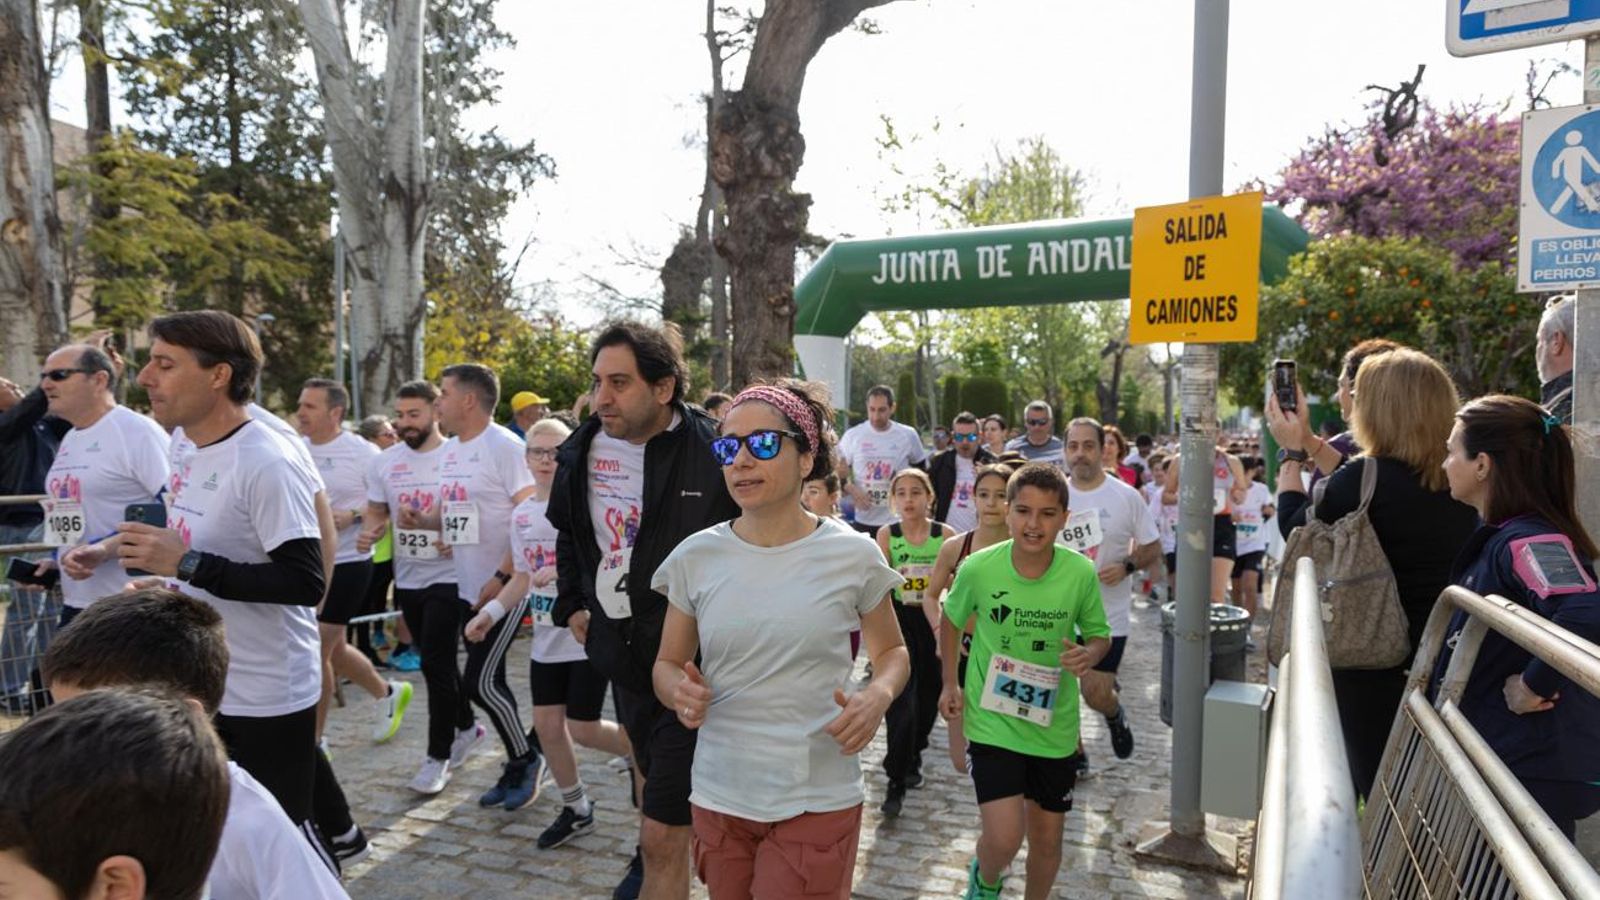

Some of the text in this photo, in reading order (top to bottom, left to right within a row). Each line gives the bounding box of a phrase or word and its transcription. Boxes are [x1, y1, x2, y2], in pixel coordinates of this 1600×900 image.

[1165, 212, 1227, 244] SALIDA
[1539, 240, 1558, 252] ES
[872, 236, 1132, 284] JUNTA DE ANDAL
[1556, 253, 1600, 265] LLEVA
[1184, 255, 1205, 281] DE
[1534, 266, 1596, 281] PERROS
[1146, 295, 1238, 325] CAMIONES
[49, 516, 81, 532] 1086
[445, 517, 469, 531] 947
[399, 533, 428, 547] 923
[1063, 523, 1092, 542] 681
[903, 578, 928, 591] 83
[1014, 608, 1068, 620] Fundación
[1014, 619, 1054, 631] Unicaja
[1000, 680, 1051, 708] 431
